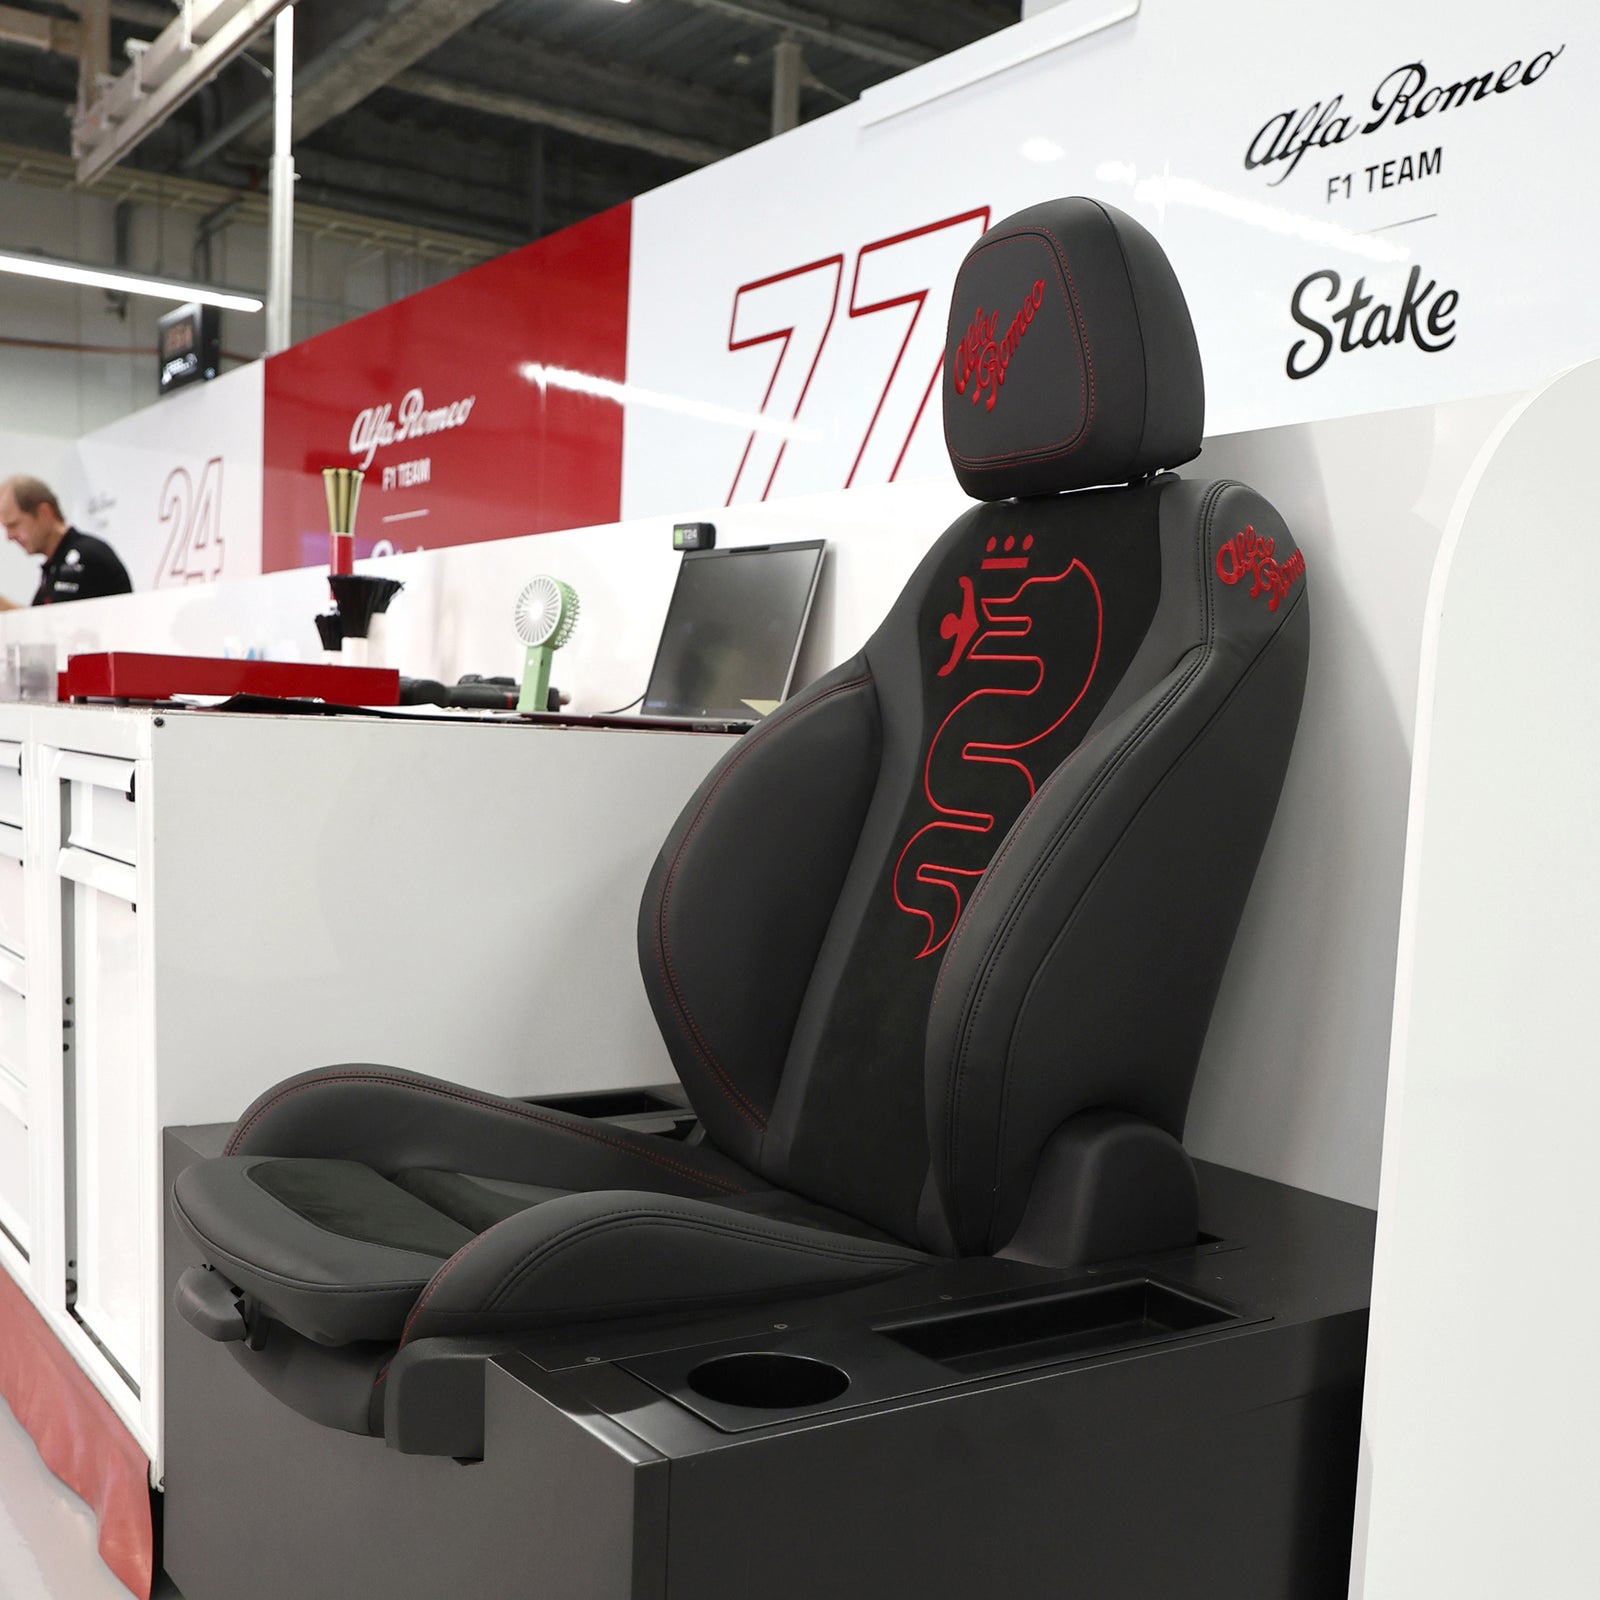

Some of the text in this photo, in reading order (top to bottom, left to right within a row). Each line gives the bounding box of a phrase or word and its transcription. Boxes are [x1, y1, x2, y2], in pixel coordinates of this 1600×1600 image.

[1244, 44, 1566, 187] Alfa Romeo
[1327, 146, 1443, 204] F1 TEAM
[724, 204, 991, 508] 77
[953, 278, 1046, 414] Alfa Romeo
[1285, 264, 1460, 380] Stake
[348, 387, 476, 471] Alfa Romeo
[382, 457, 431, 491] F1 TEAM
[153, 455, 225, 590] 24
[1215, 523, 1275, 600] Alfa
